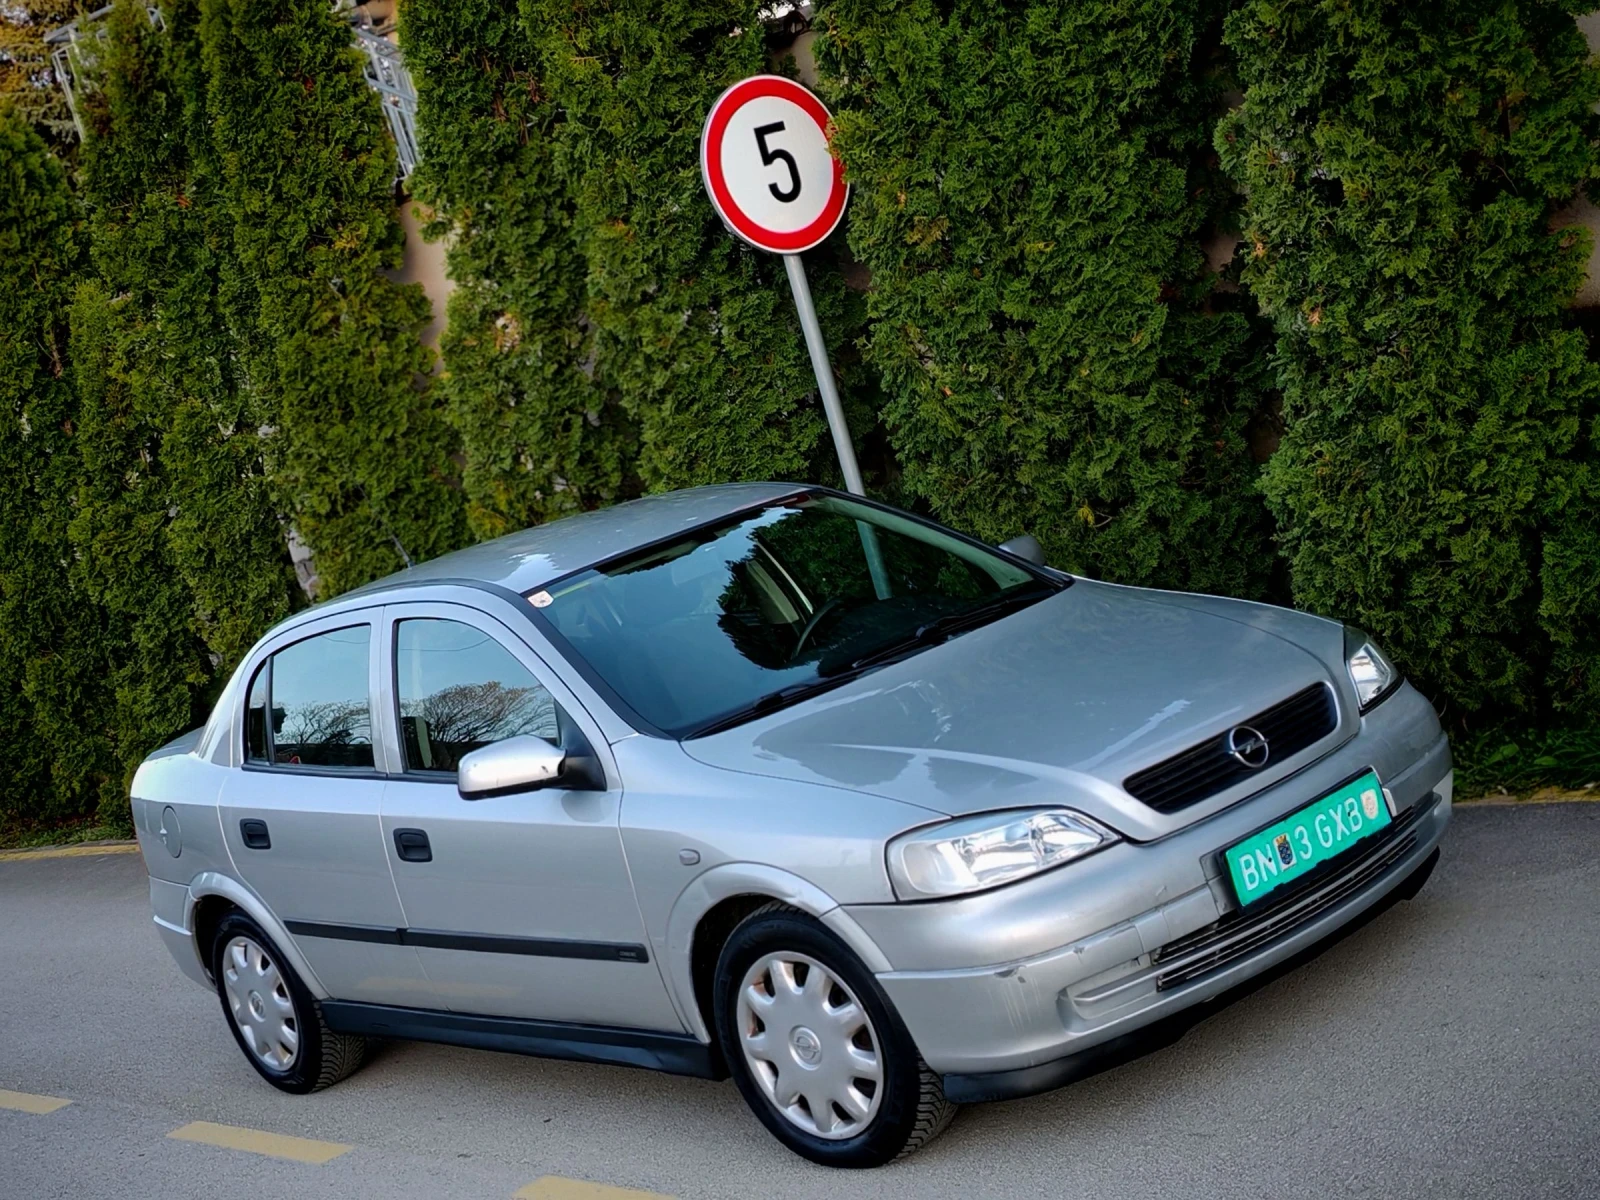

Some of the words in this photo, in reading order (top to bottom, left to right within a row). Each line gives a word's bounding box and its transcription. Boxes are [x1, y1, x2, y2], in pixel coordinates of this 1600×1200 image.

[753, 120, 802, 203] 5
[1238, 843, 1278, 891] BN
[1294, 825, 1312, 860] 3
[1314, 797, 1363, 848] GXB
